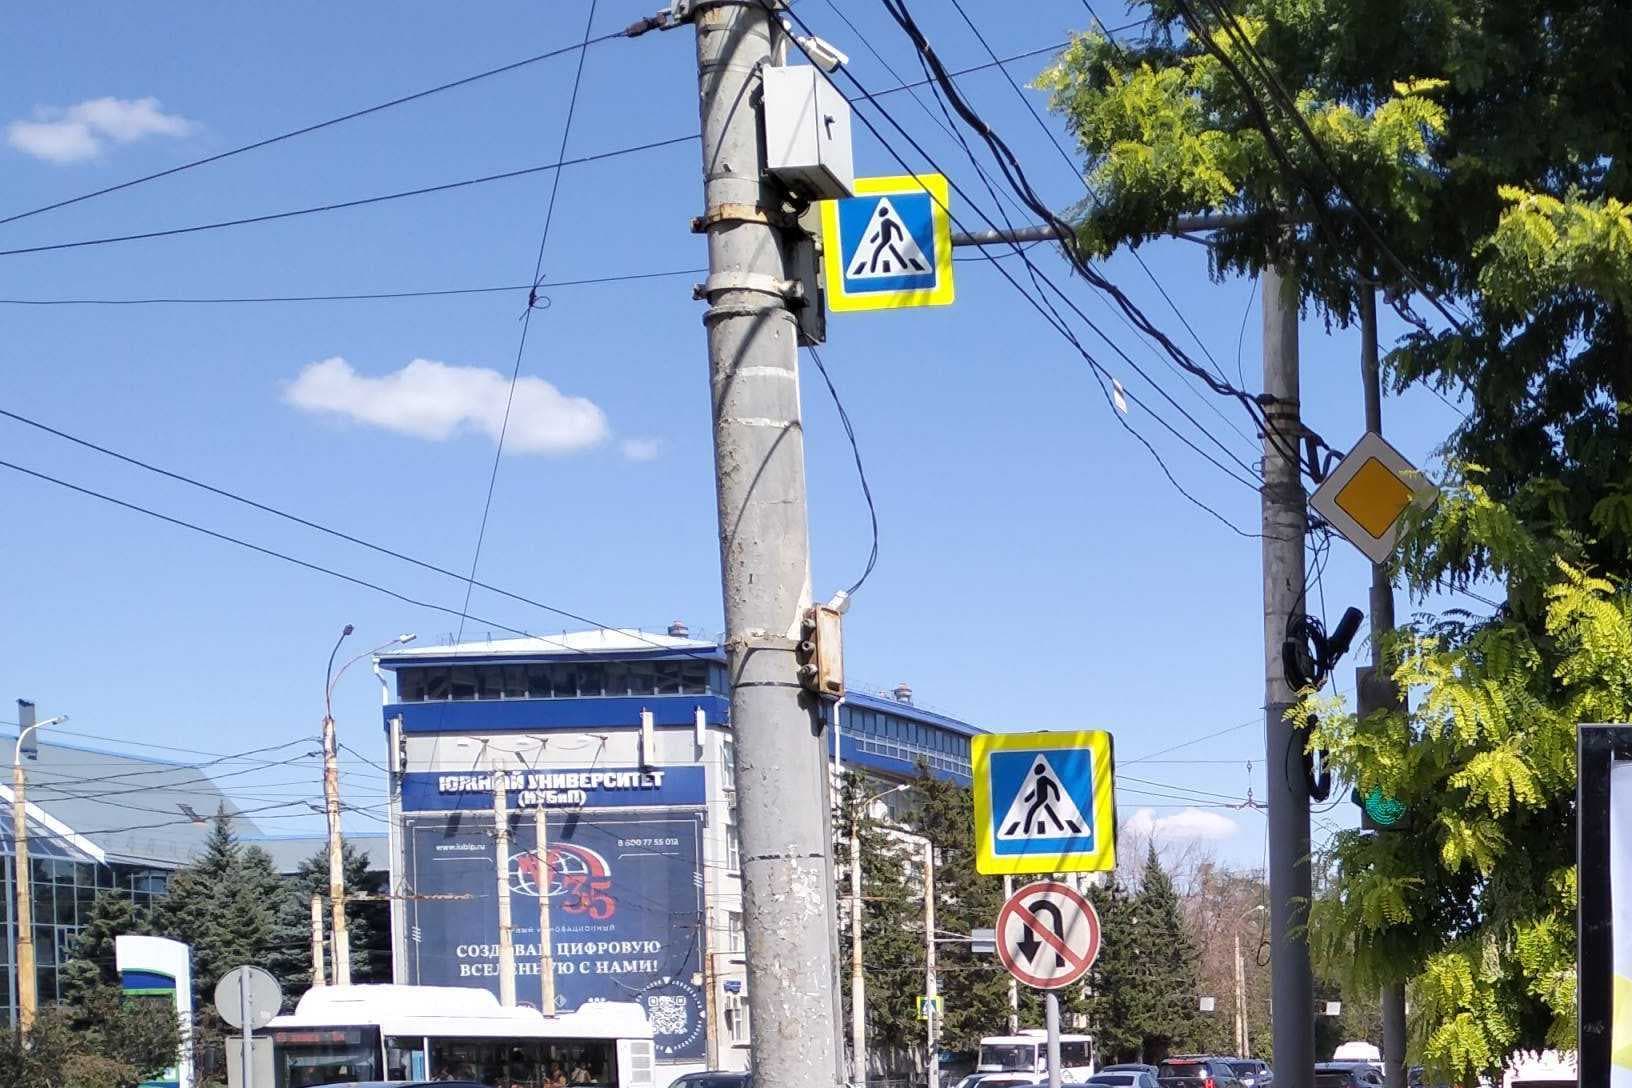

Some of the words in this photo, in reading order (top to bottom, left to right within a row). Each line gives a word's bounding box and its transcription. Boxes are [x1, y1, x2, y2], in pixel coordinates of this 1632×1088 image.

[527, 771, 664, 790] УНИВЕРСИТЕТ
[456, 942, 548, 959] СОЗДВА
[557, 940, 661, 957] ЦИФРОВУЮ
[460, 960, 574, 977] ВСЕННЮ
[579, 961, 590, 975] С
[595, 959, 658, 974] НАМИ!
